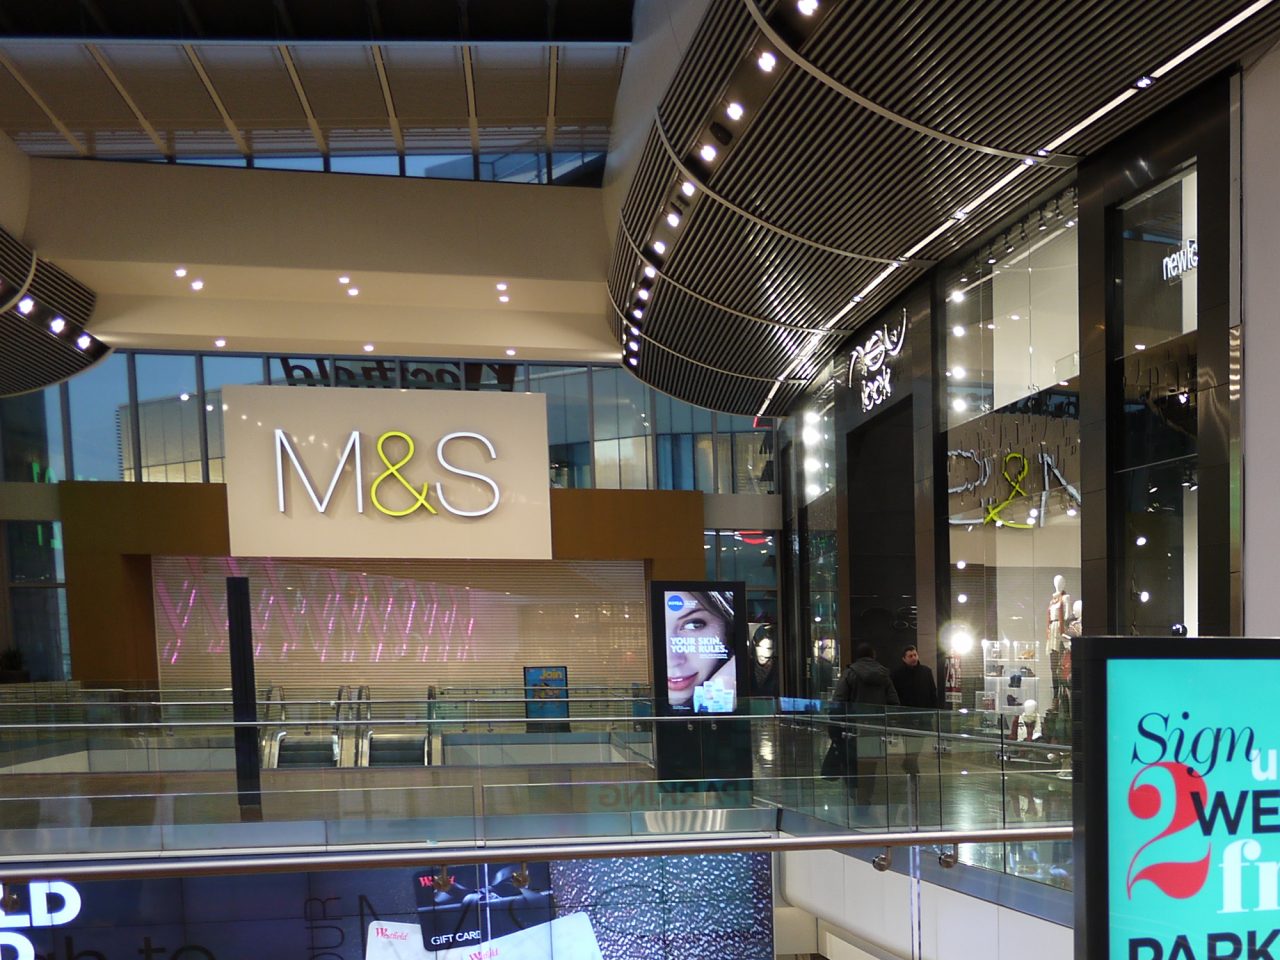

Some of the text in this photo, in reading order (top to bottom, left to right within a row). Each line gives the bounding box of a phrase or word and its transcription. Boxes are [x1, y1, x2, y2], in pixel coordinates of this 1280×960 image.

[274, 429, 500, 517] M&S
[670, 637, 696, 645] YOUR
[671, 645, 728, 653] YOUR RULES.
[1131, 711, 1260, 777] Sign
[1127, 761, 1212, 900] 2
[431, 931, 481, 945] GIFT CARD
